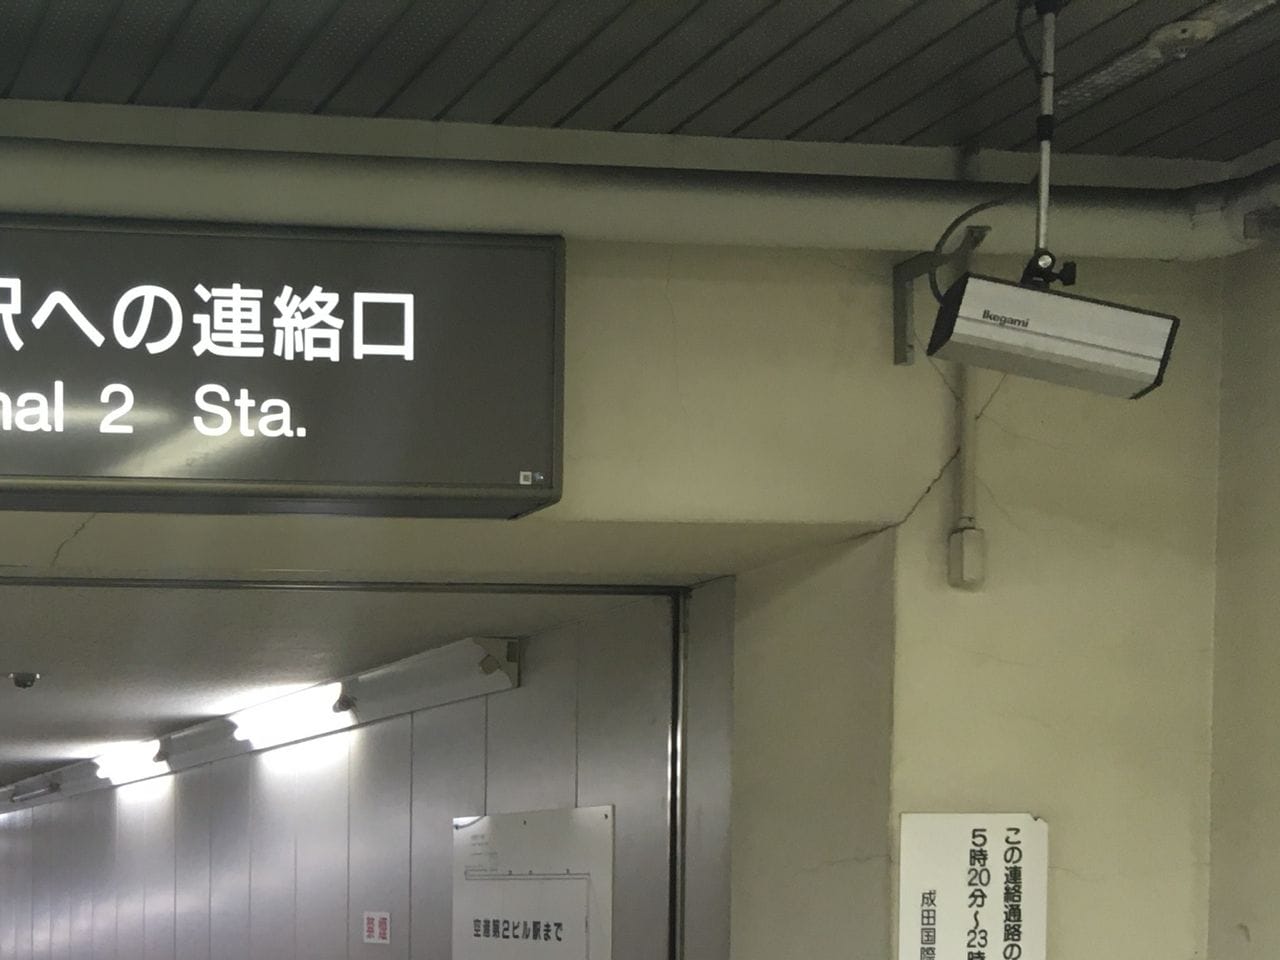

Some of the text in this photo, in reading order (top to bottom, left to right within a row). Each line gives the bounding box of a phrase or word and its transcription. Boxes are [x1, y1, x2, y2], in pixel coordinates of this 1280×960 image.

[982, 309, 1030, 328] Ikegami
[99, 384, 135, 434] 2
[193, 384, 307, 437] Sta.
[473, 918, 563, 942] 空港第2ビル駅まで
